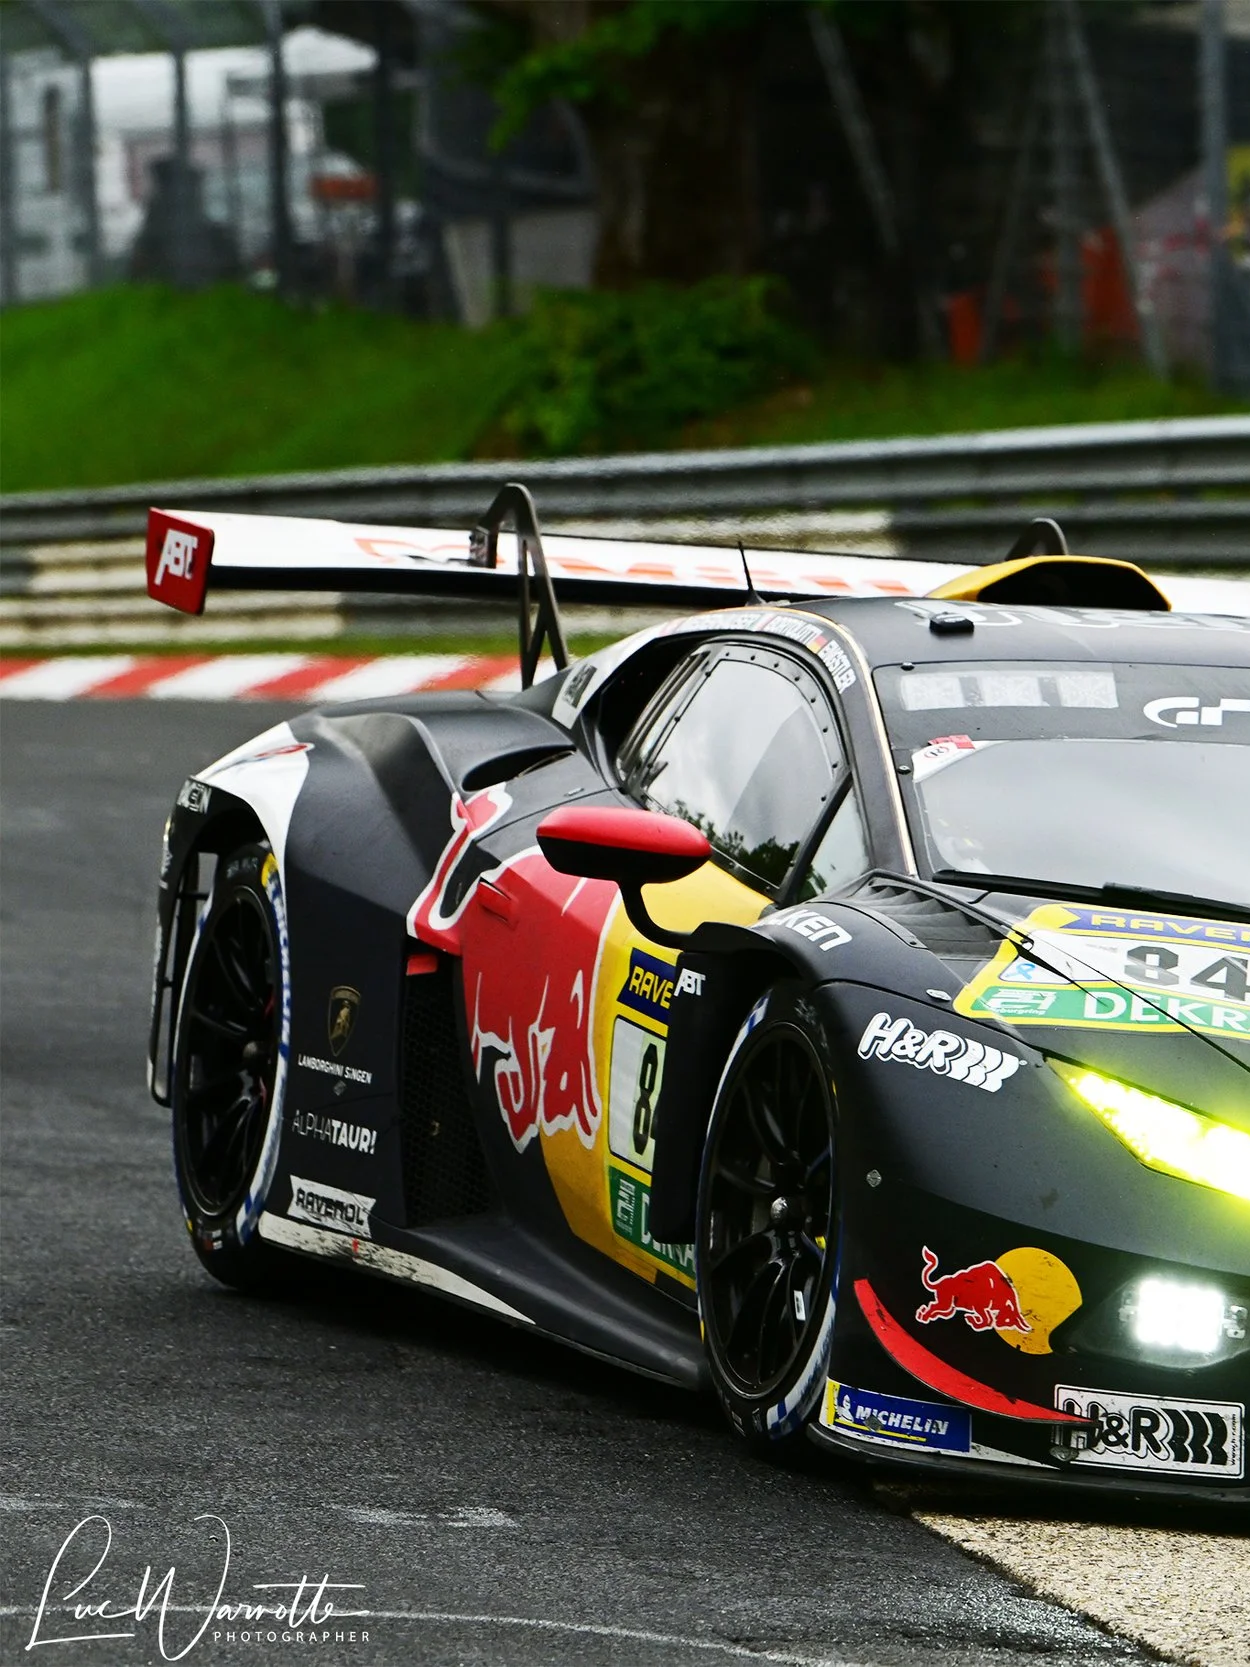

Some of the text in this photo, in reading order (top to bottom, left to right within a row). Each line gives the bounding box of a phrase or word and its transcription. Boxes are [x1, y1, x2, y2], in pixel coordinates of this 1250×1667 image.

[154, 528, 198, 586] ABT
[675, 968, 706, 997] ABT
[297, 1054, 372, 1085] LAMBORGHINI SINGEN
[632, 1042, 658, 1156] 8
[296, 1187, 366, 1226] RAVENOL
